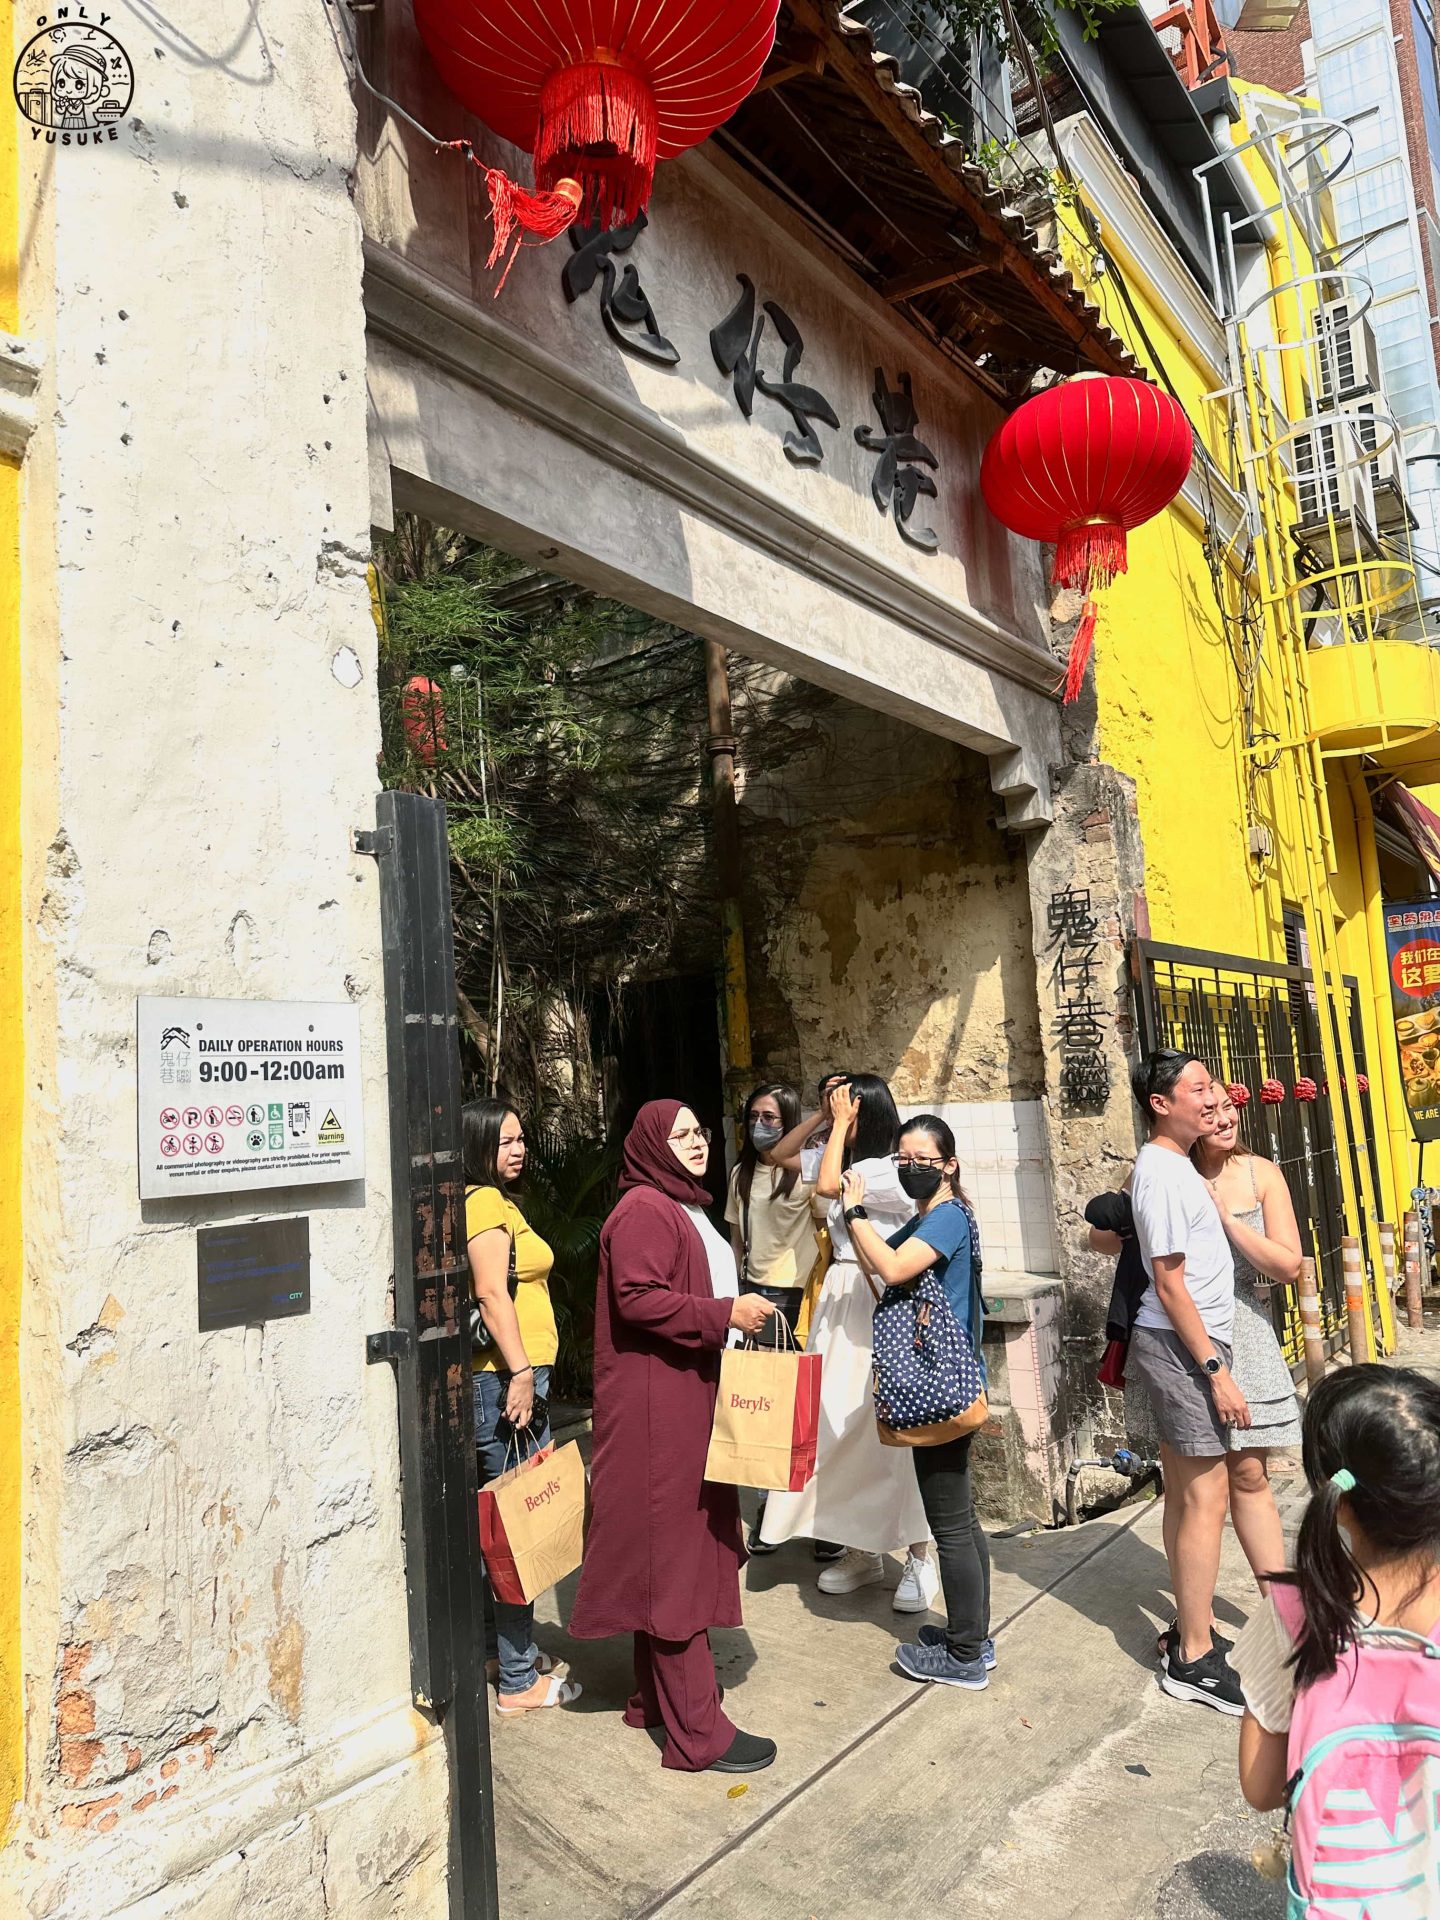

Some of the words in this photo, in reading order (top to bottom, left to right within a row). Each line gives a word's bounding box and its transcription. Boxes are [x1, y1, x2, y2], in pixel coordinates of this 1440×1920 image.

[1400, 947, 1440, 966] 我们在
[1050, 883, 1107, 1047] 鬼仔巷
[1401, 963, 1440, 989] 这里
[198, 1039, 234, 1052] DAILY
[237, 1039, 302, 1052] OPERATION
[306, 1039, 344, 1052] HOURS
[1065, 1051, 1108, 1068] KWAI
[1068, 1085, 1111, 1101] HONG
[1413, 1110, 1425, 1121] WE
[1425, 1108, 1440, 1120] ARE
[317, 1132, 345, 1141] Warning
[164, 1162, 194, 1170] commercial
[194, 1160, 225, 1168] photography
[232, 1155, 261, 1165] videography
[289, 1291, 303, 1300] CITY
[730, 1393, 771, 1415] Beryl's
[524, 1480, 561, 1512] Beryl's
